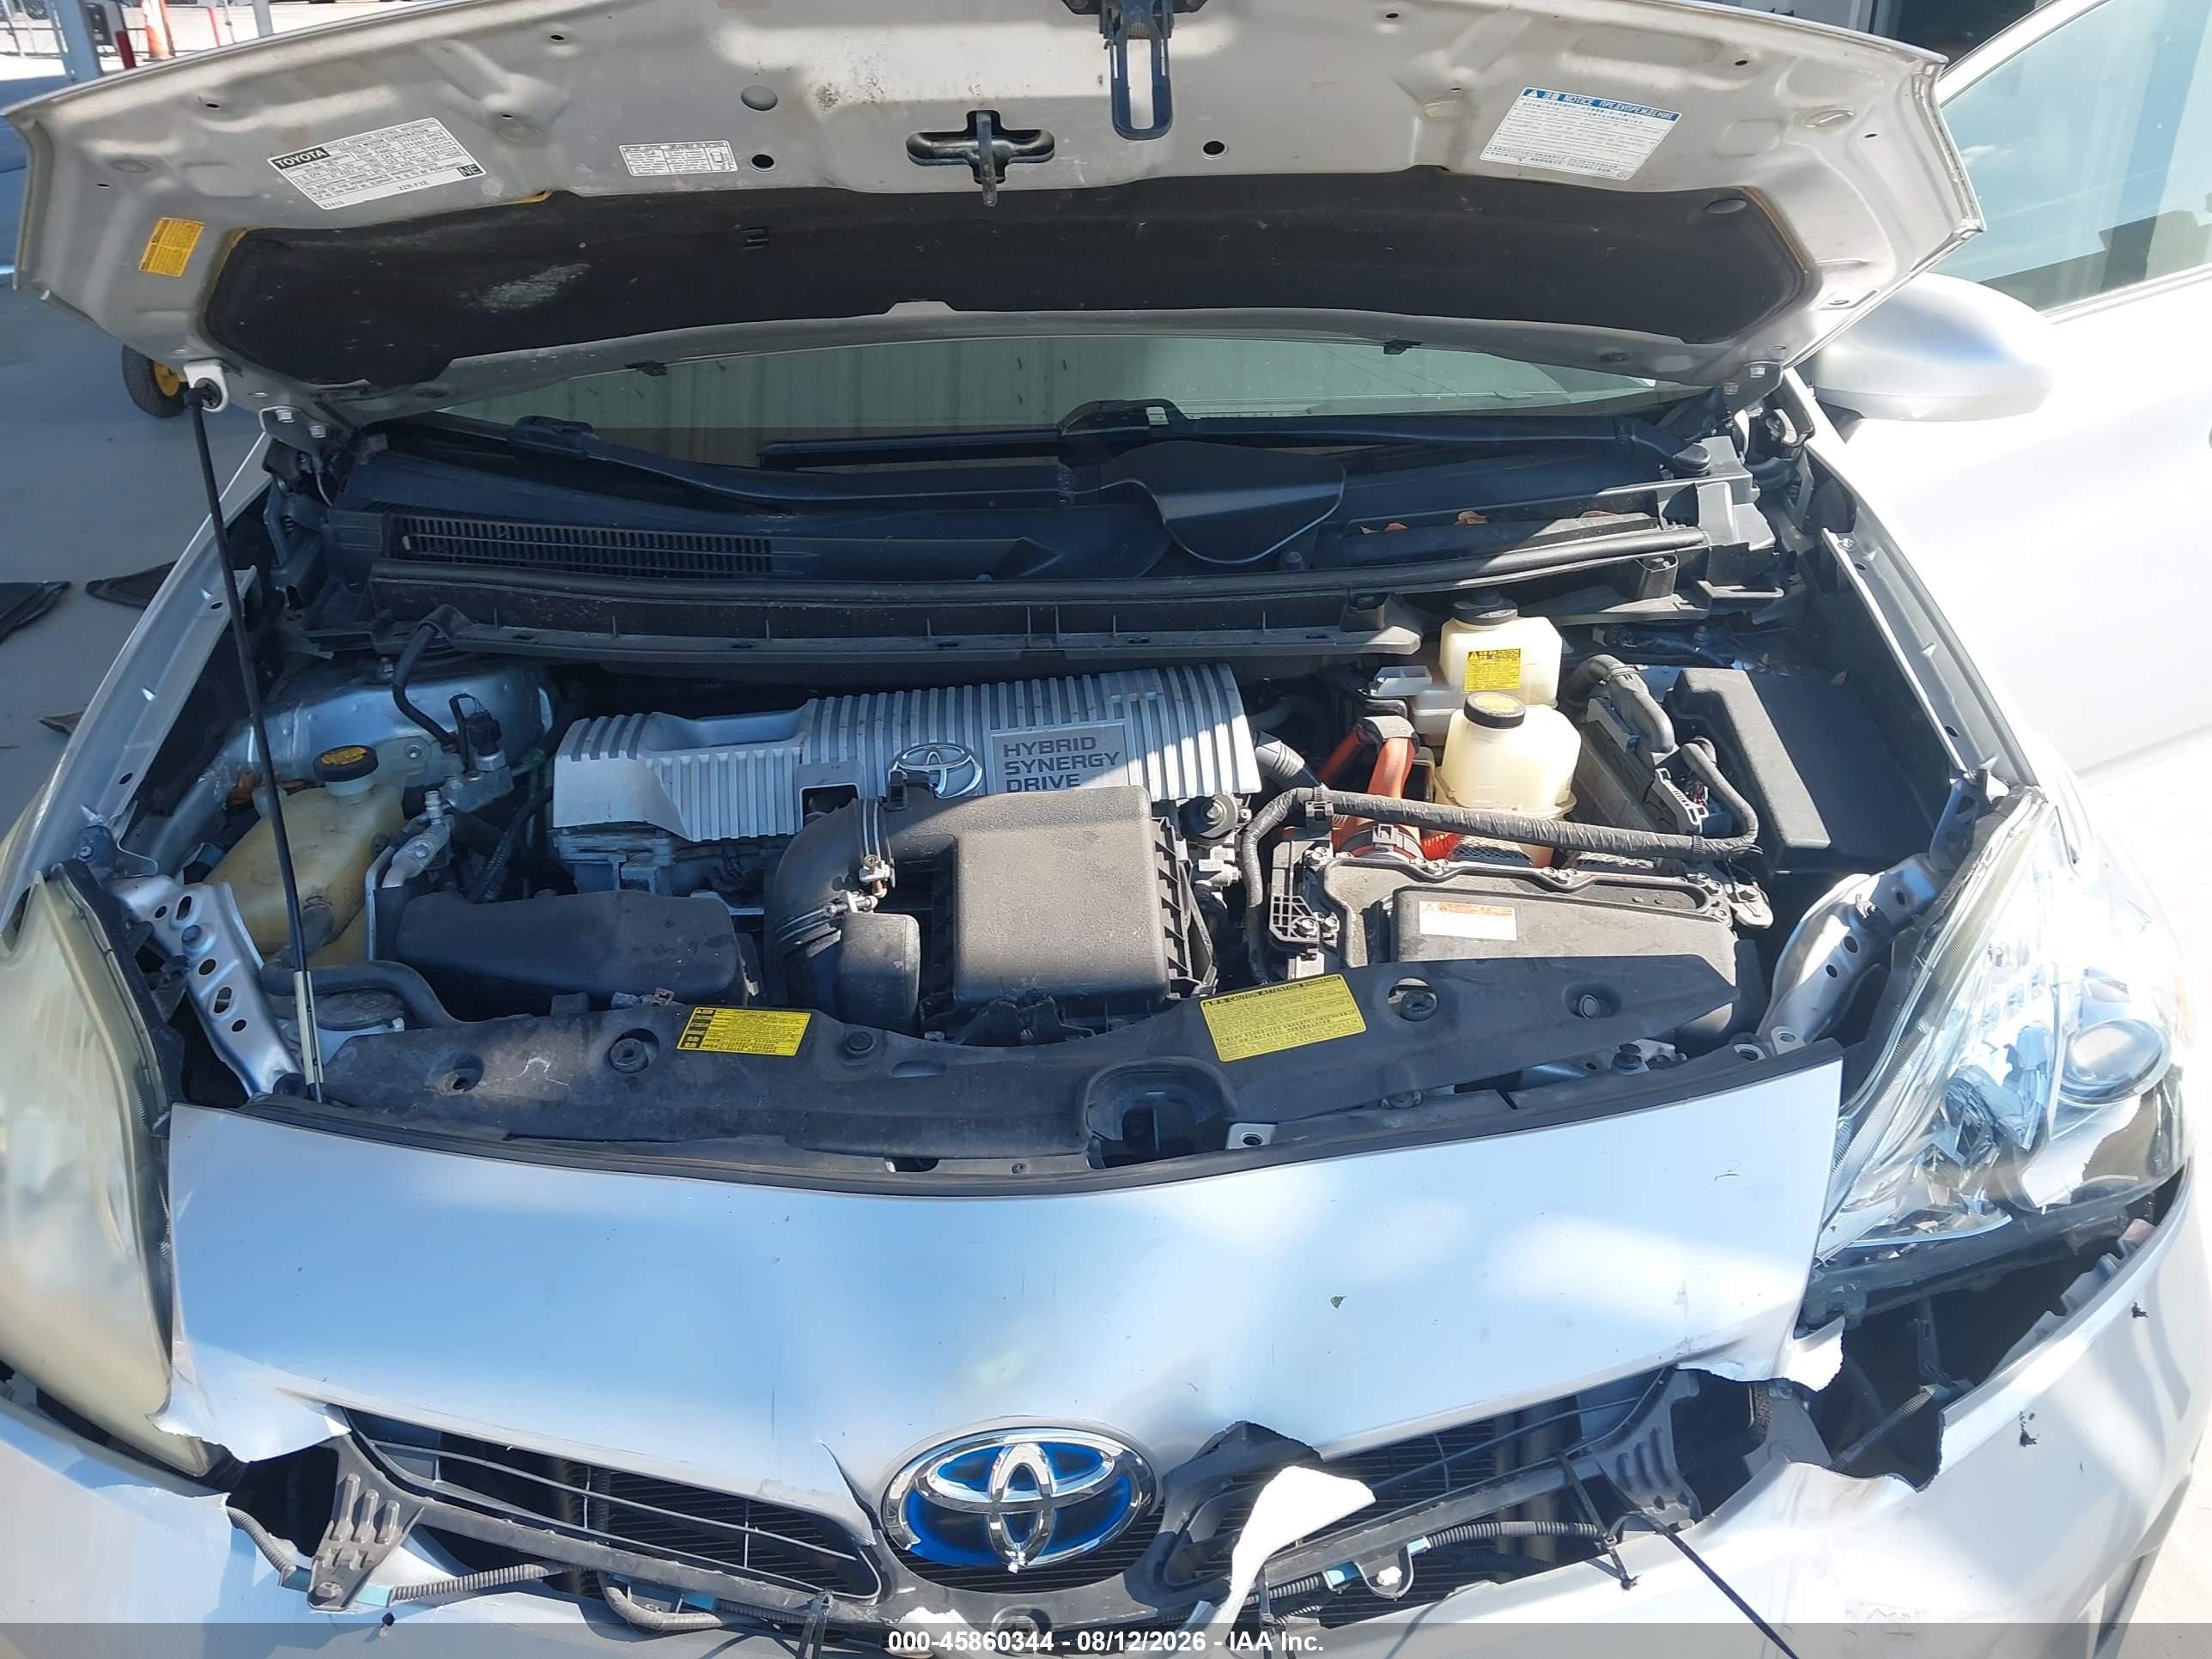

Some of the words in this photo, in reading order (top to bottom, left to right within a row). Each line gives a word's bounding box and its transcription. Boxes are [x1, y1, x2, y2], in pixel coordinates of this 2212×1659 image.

[1565, 93, 1595, 106] NOTICE
[274, 149, 327, 167] TOYOTA
[459, 166, 482, 176] NE
[1004, 736, 1097, 757] HYBRID
[1005, 751, 1120, 775] SYNERGY
[1006, 774, 1079, 793] DRIVE
[1229, 992, 1260, 1002] CAUTION
[1262, 984, 1300, 996] ATTENTION
